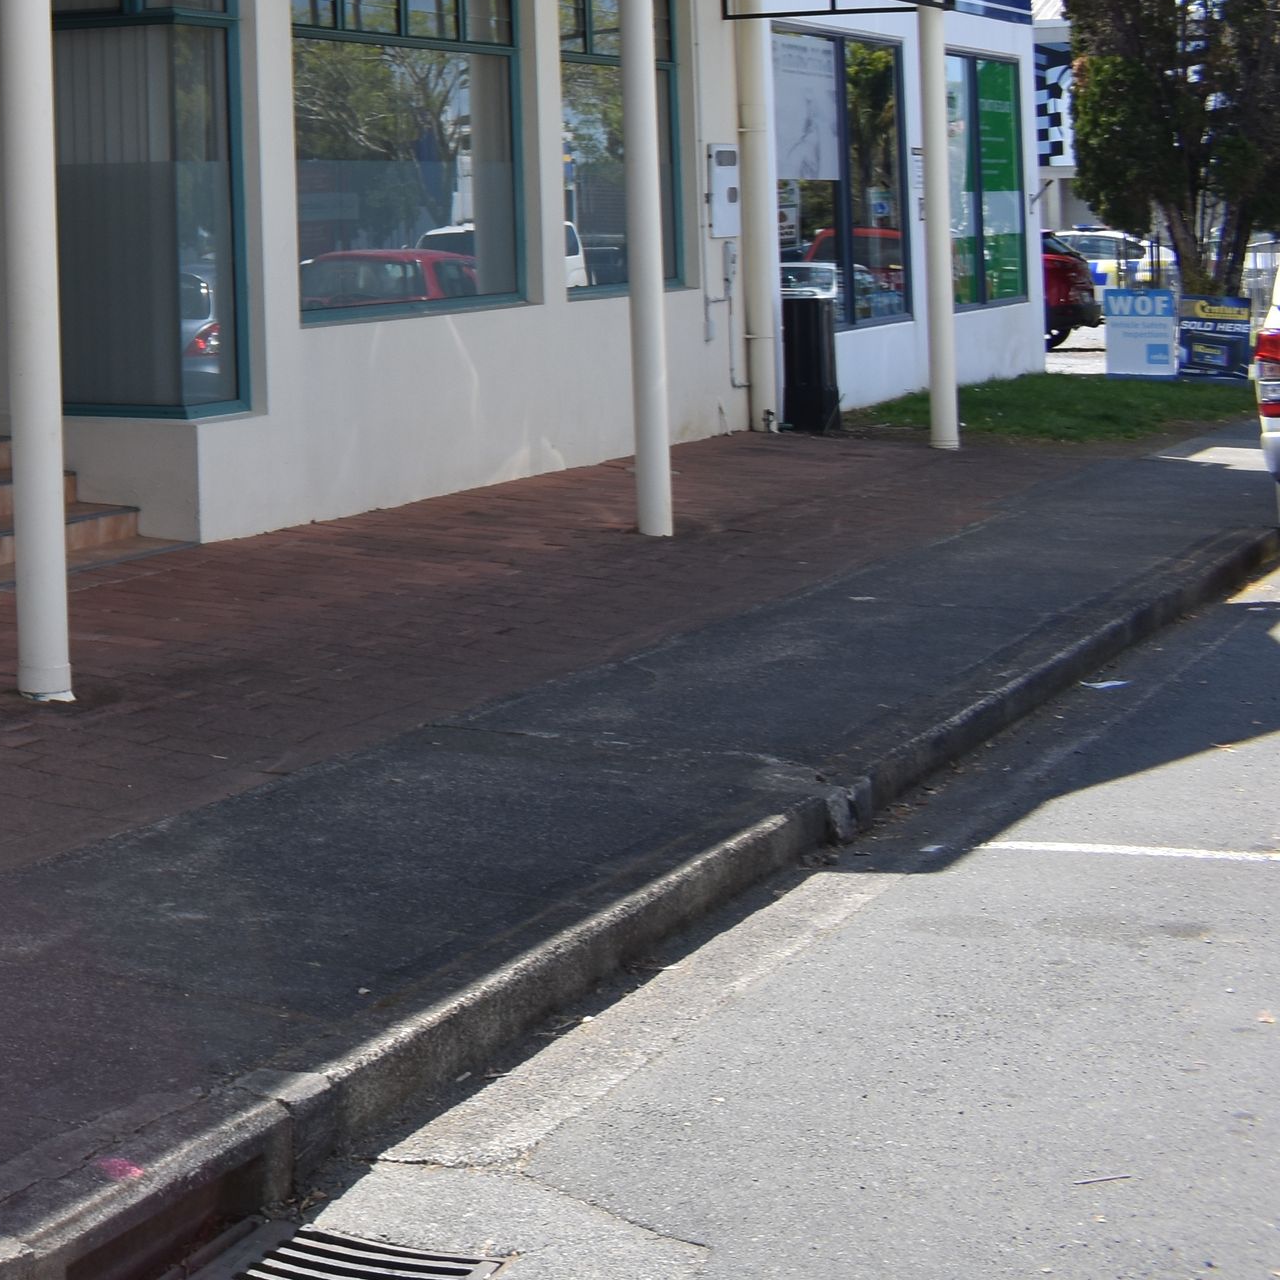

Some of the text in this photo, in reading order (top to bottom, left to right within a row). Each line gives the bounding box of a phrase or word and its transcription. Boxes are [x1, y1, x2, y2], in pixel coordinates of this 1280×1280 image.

[1107, 295, 1169, 316] WOF
[1180, 320, 1215, 332] SOLD
[1216, 322, 1251, 333] HERE
